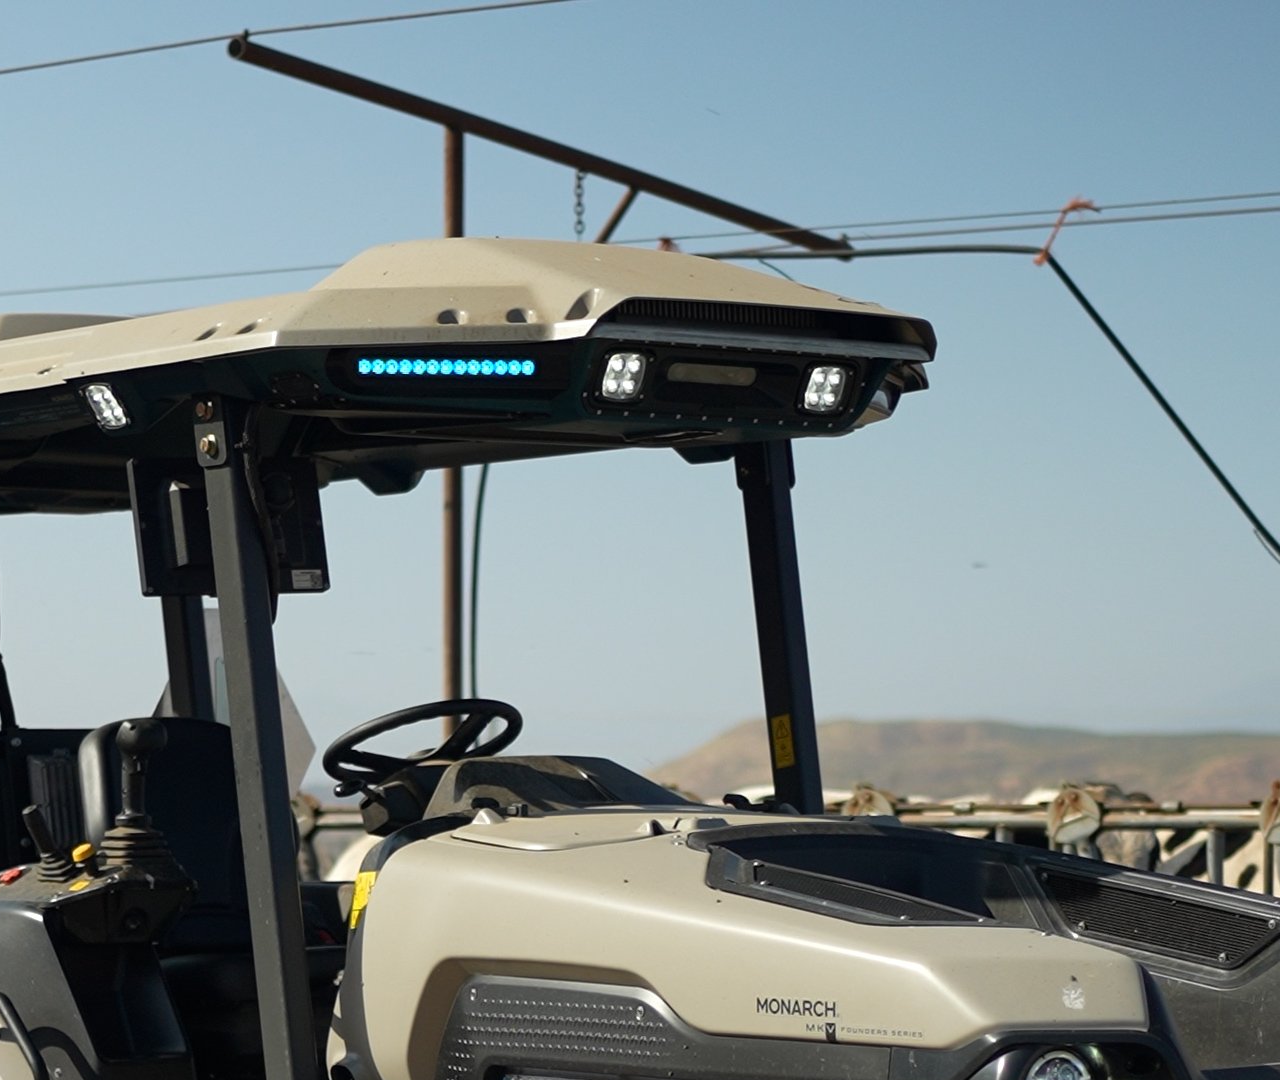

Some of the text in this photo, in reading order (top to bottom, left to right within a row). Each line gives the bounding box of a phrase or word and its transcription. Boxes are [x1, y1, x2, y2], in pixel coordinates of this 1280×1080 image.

[756, 997, 837, 1018] MONARCH
[840, 1026, 889, 1036] FOUNDERS
[891, 1030, 924, 1038] SERIES
